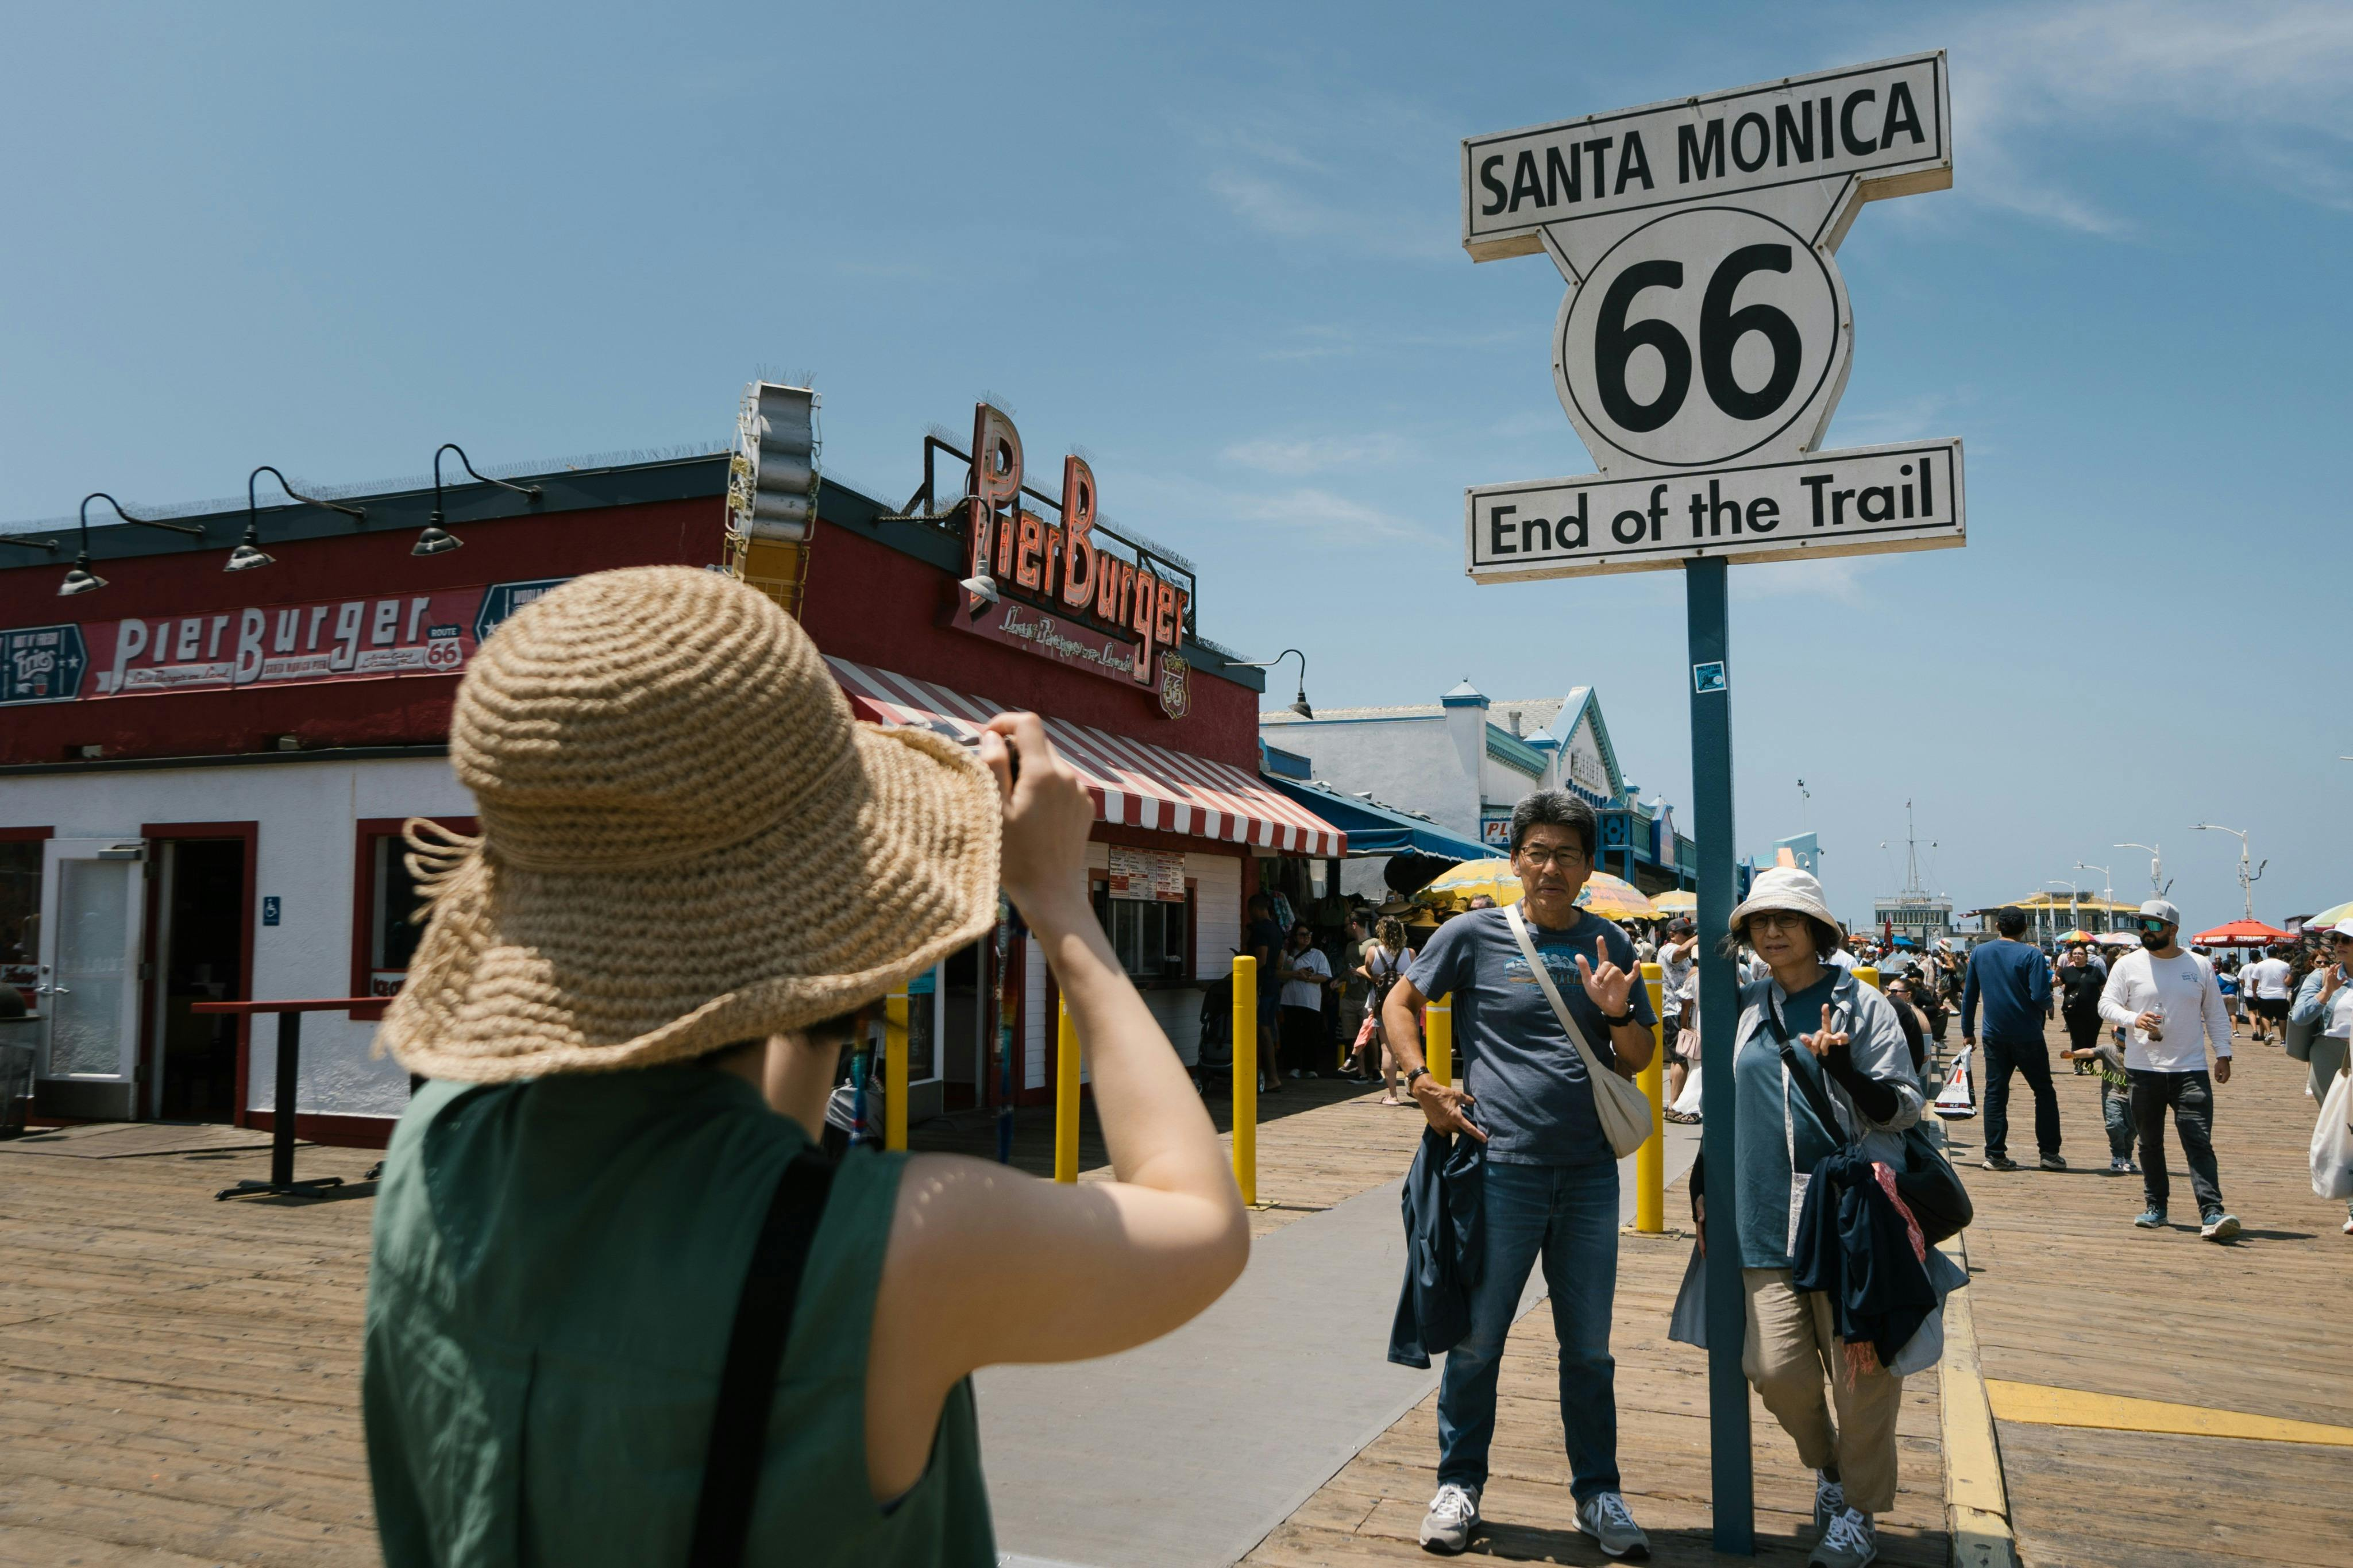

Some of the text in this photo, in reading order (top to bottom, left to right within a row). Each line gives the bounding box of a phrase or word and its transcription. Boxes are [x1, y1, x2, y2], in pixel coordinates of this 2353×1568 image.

[1480, 80, 1926, 216] SANTA MONICA
[1594, 242, 1803, 433] 66
[1491, 457, 1933, 555] End of the Trail
[428, 642, 457, 665] 66
[431, 627, 457, 637] ROUTE
